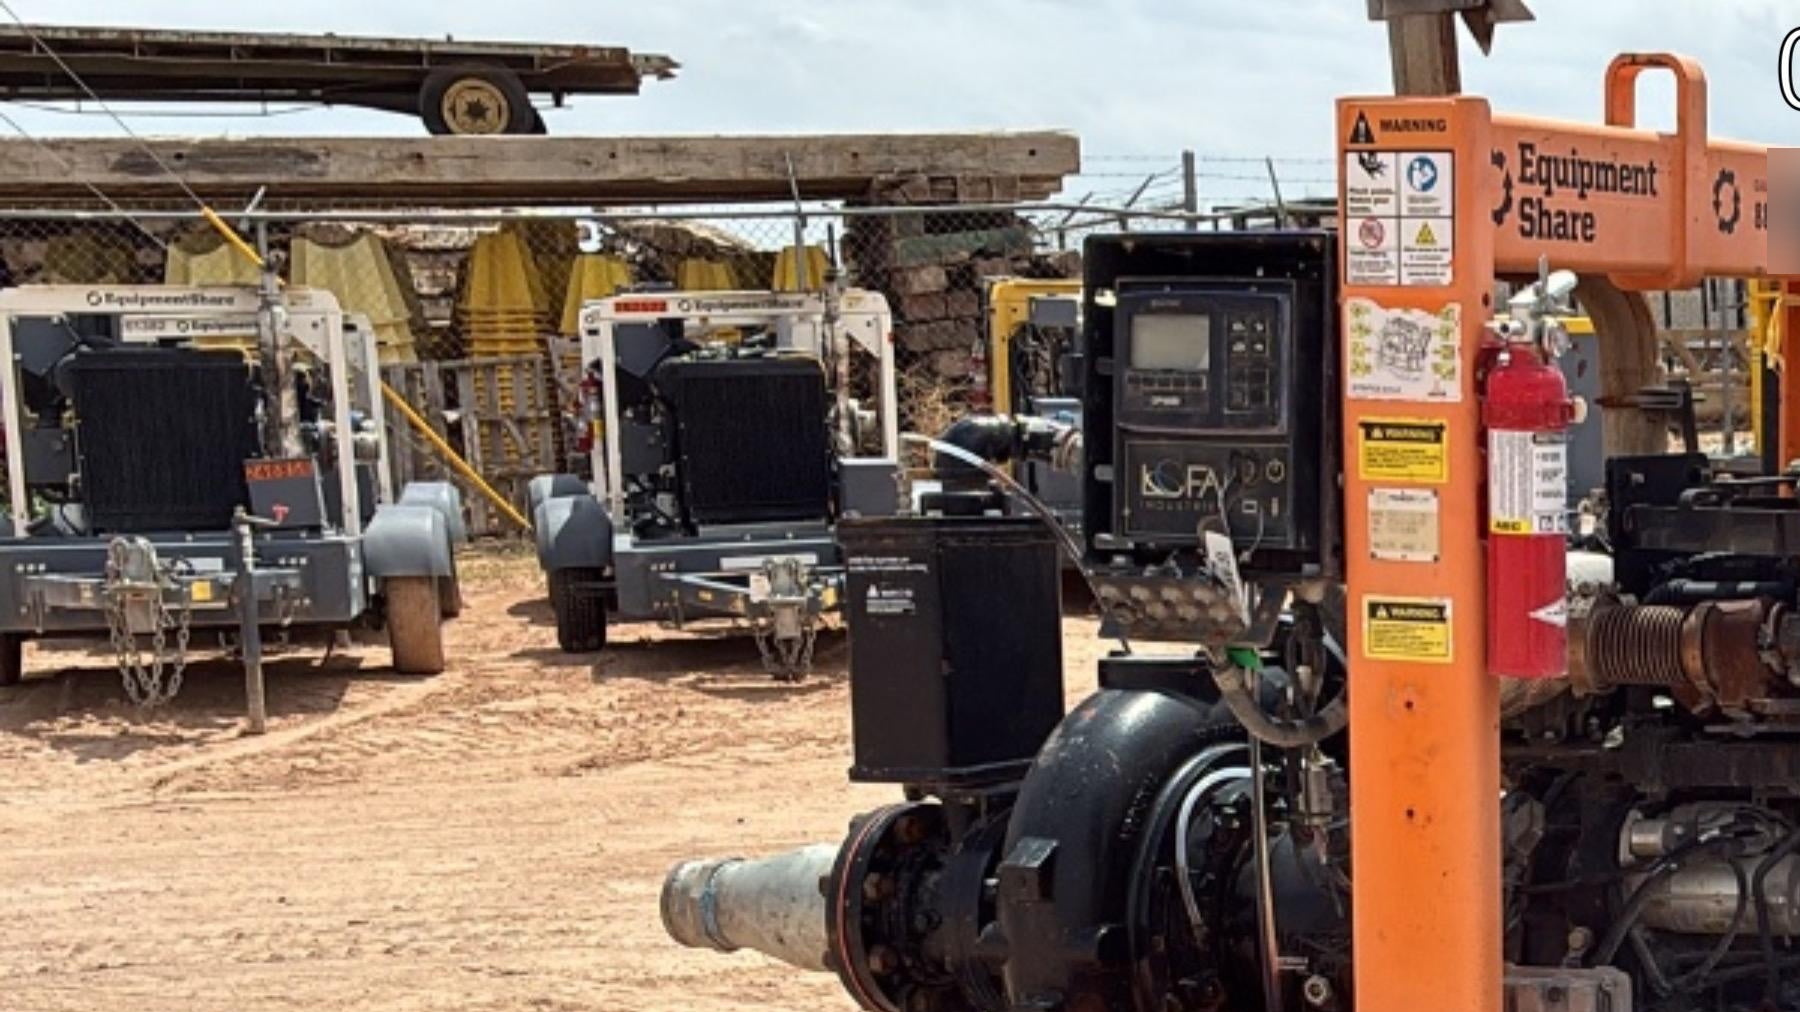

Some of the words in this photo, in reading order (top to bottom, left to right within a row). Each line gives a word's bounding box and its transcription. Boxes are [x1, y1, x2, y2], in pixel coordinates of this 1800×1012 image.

[1380, 119, 1447, 132] WARNING
[1518, 142, 1657, 199] Equipment
[1518, 197, 1596, 243] Share
[104, 292, 235, 307] EquipmentShare
